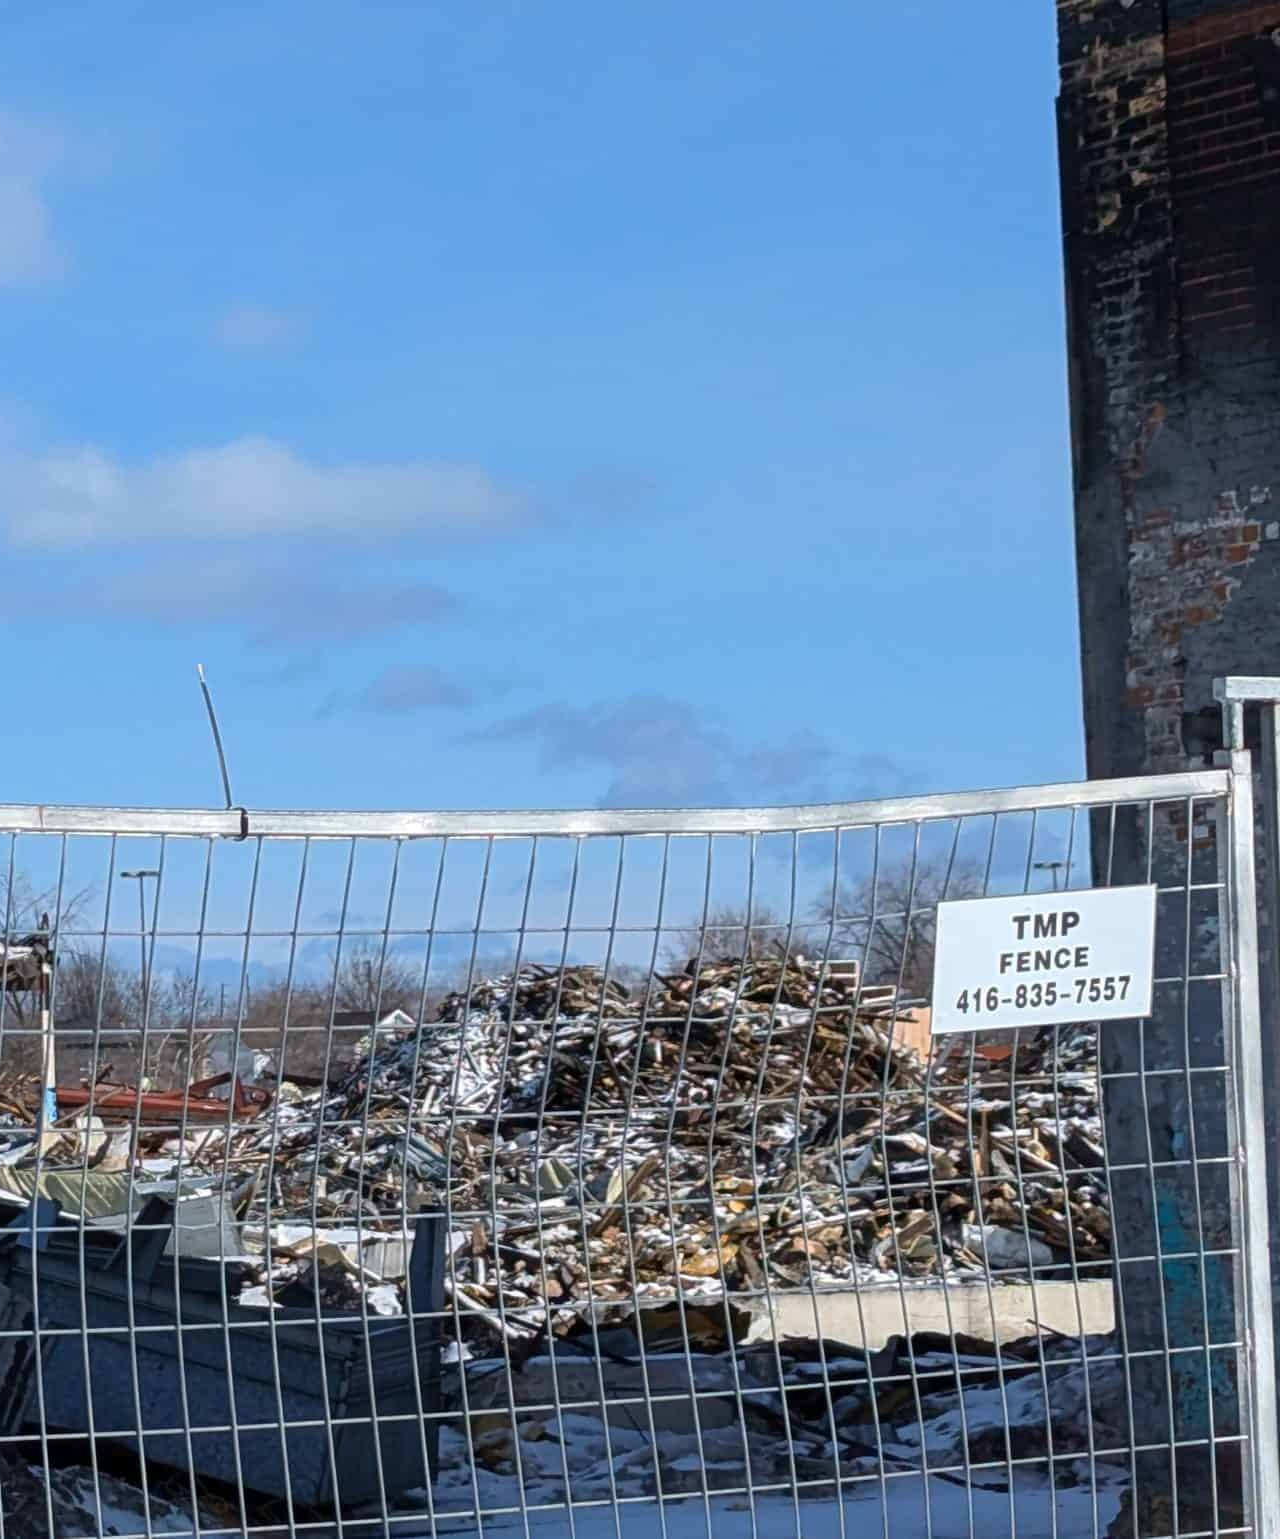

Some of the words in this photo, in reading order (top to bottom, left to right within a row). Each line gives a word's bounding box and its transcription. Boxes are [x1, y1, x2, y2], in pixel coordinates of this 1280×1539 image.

[1012, 911, 1080, 939] TMP
[999, 946, 1089, 974] FENCE
[956, 975, 1130, 1014] 416-835-7557
